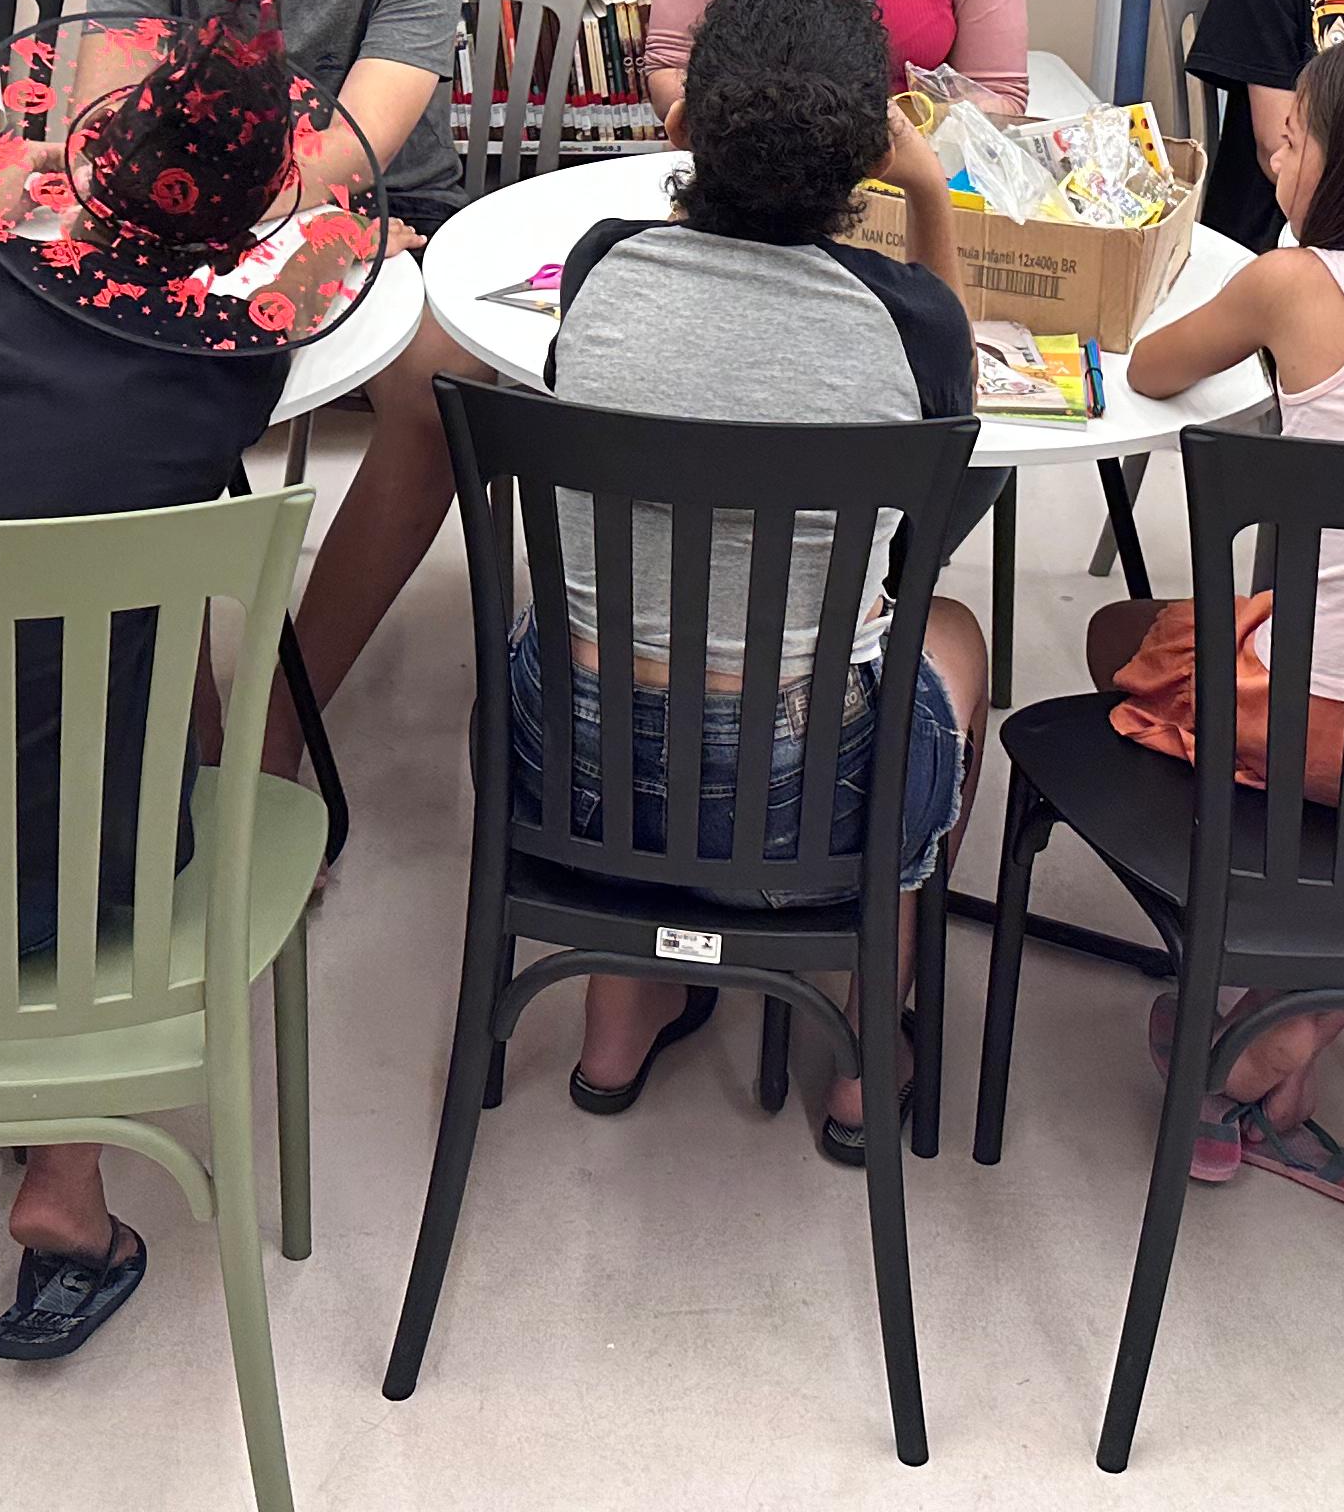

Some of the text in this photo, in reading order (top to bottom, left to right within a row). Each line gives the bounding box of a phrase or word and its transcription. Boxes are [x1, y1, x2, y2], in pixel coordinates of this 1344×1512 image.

[861, 228, 883, 245] NAN
[1018, 252, 1059, 274] 12x400g
[1061, 258, 1077, 274] BR
